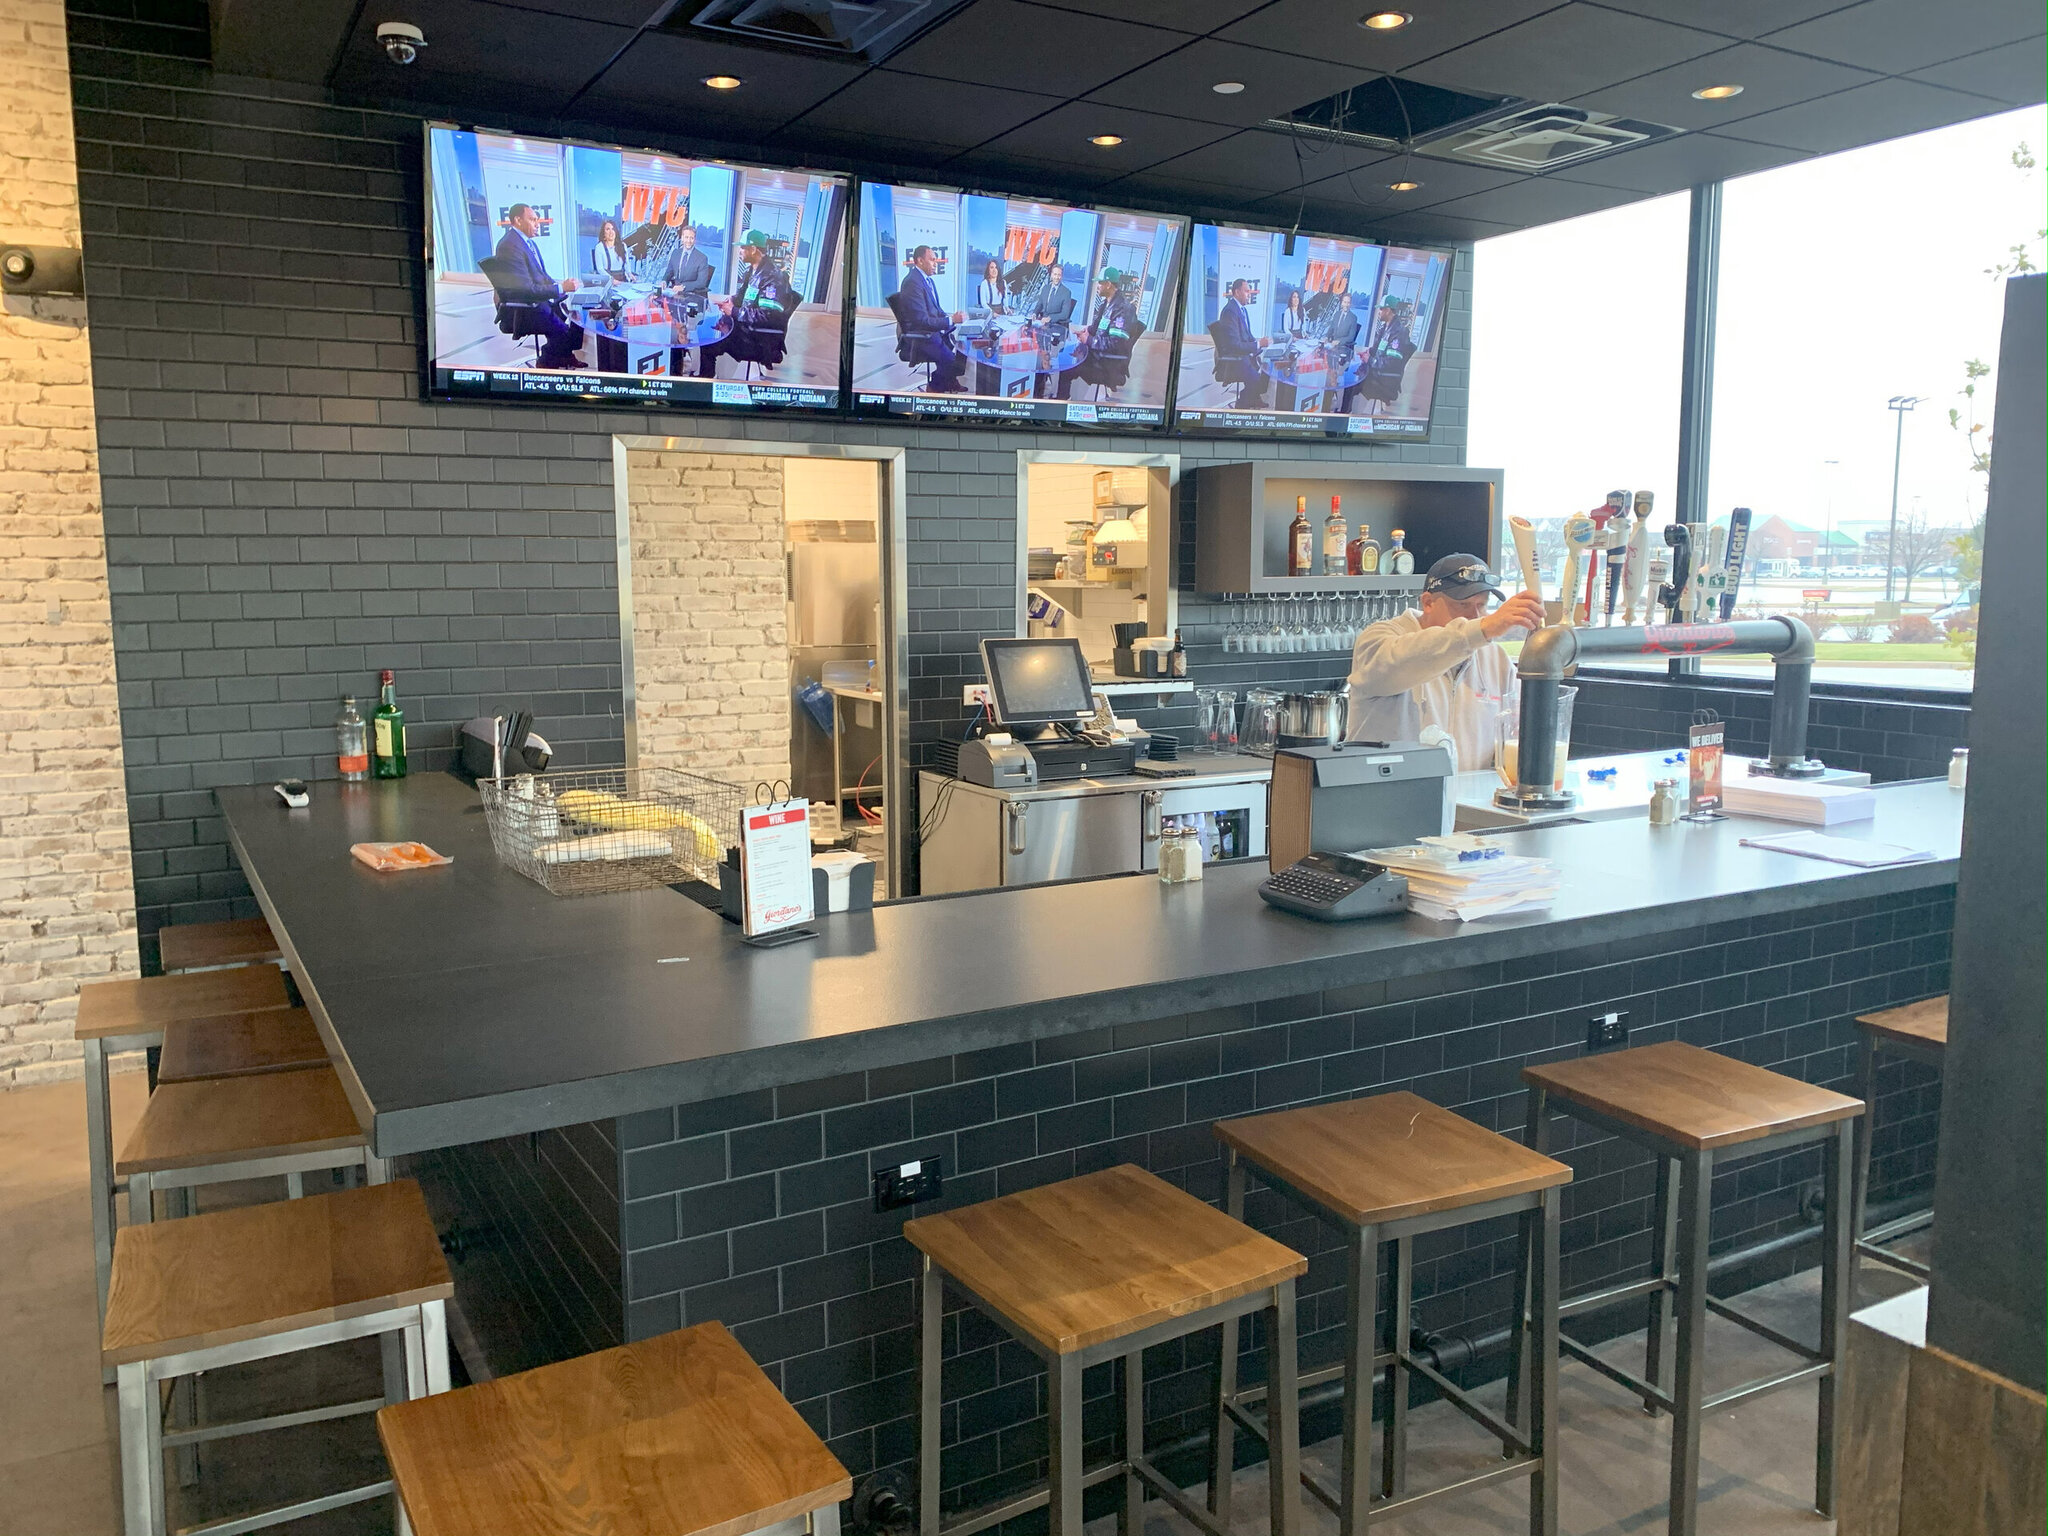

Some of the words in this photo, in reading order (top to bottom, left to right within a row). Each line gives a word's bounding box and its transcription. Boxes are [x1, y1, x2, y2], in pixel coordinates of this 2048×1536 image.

[622, 182, 690, 227] NYC
[1005, 227, 1060, 265] NYC
[453, 370, 485, 381] ESPN
[493, 372, 510, 380] WEEK
[524, 373, 564, 383] Buccaneers
[576, 377, 601, 385] Falcons
[629, 387, 649, 395] chance
[715, 384, 744, 392] SATURDAY
[757, 391, 791, 401] MICHIGAN
[799, 393, 826, 403] INDIANA
[859, 394, 885, 404] ESPN
[916, 396, 947, 405] Buccaneers
[1730, 523, 1747, 565] LIGHT
[1725, 565, 1740, 595] BUD
[1692, 735, 1701, 747] WE
[1701, 732, 1724, 746] DELIVER
[768, 812, 786, 825] WINE
